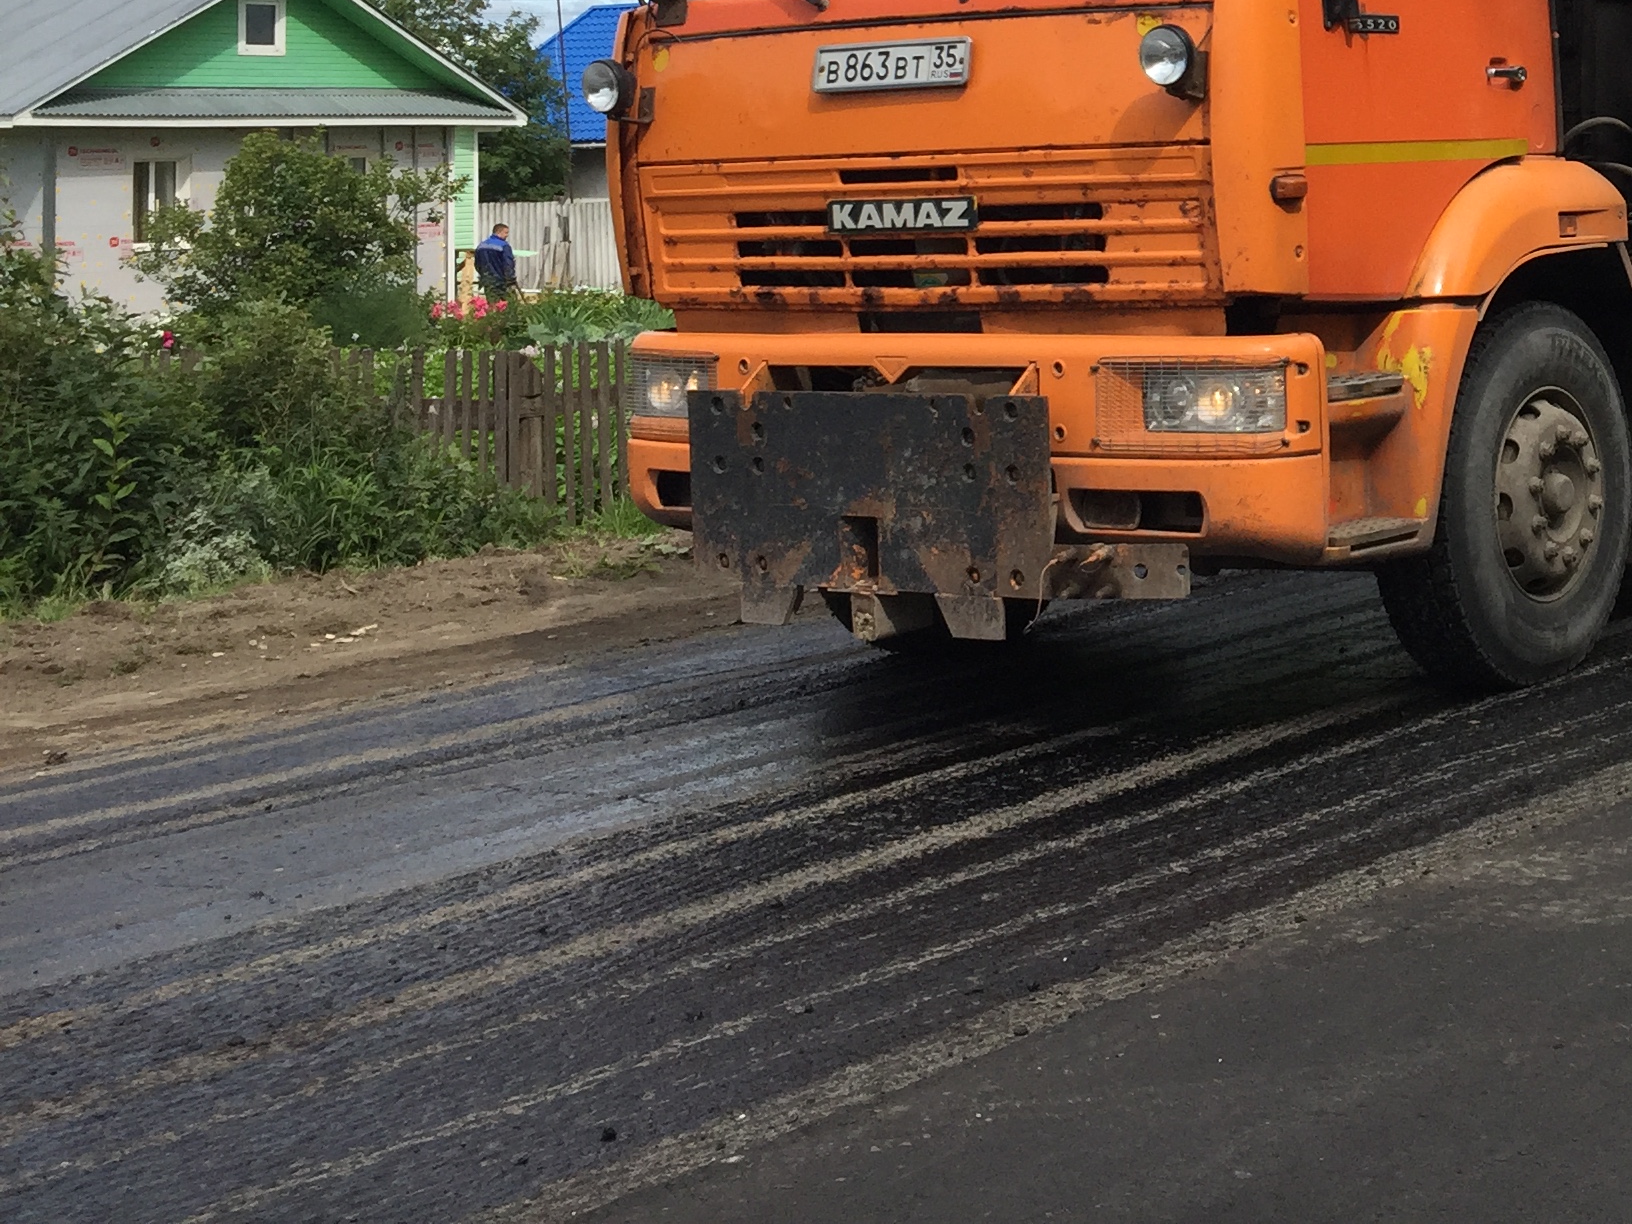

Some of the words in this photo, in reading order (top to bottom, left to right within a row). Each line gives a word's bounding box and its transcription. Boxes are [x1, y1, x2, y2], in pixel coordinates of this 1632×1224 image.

[932, 44, 958, 70] 35
[930, 69, 950, 80] RUS
[831, 200, 970, 230] KAMAZ
